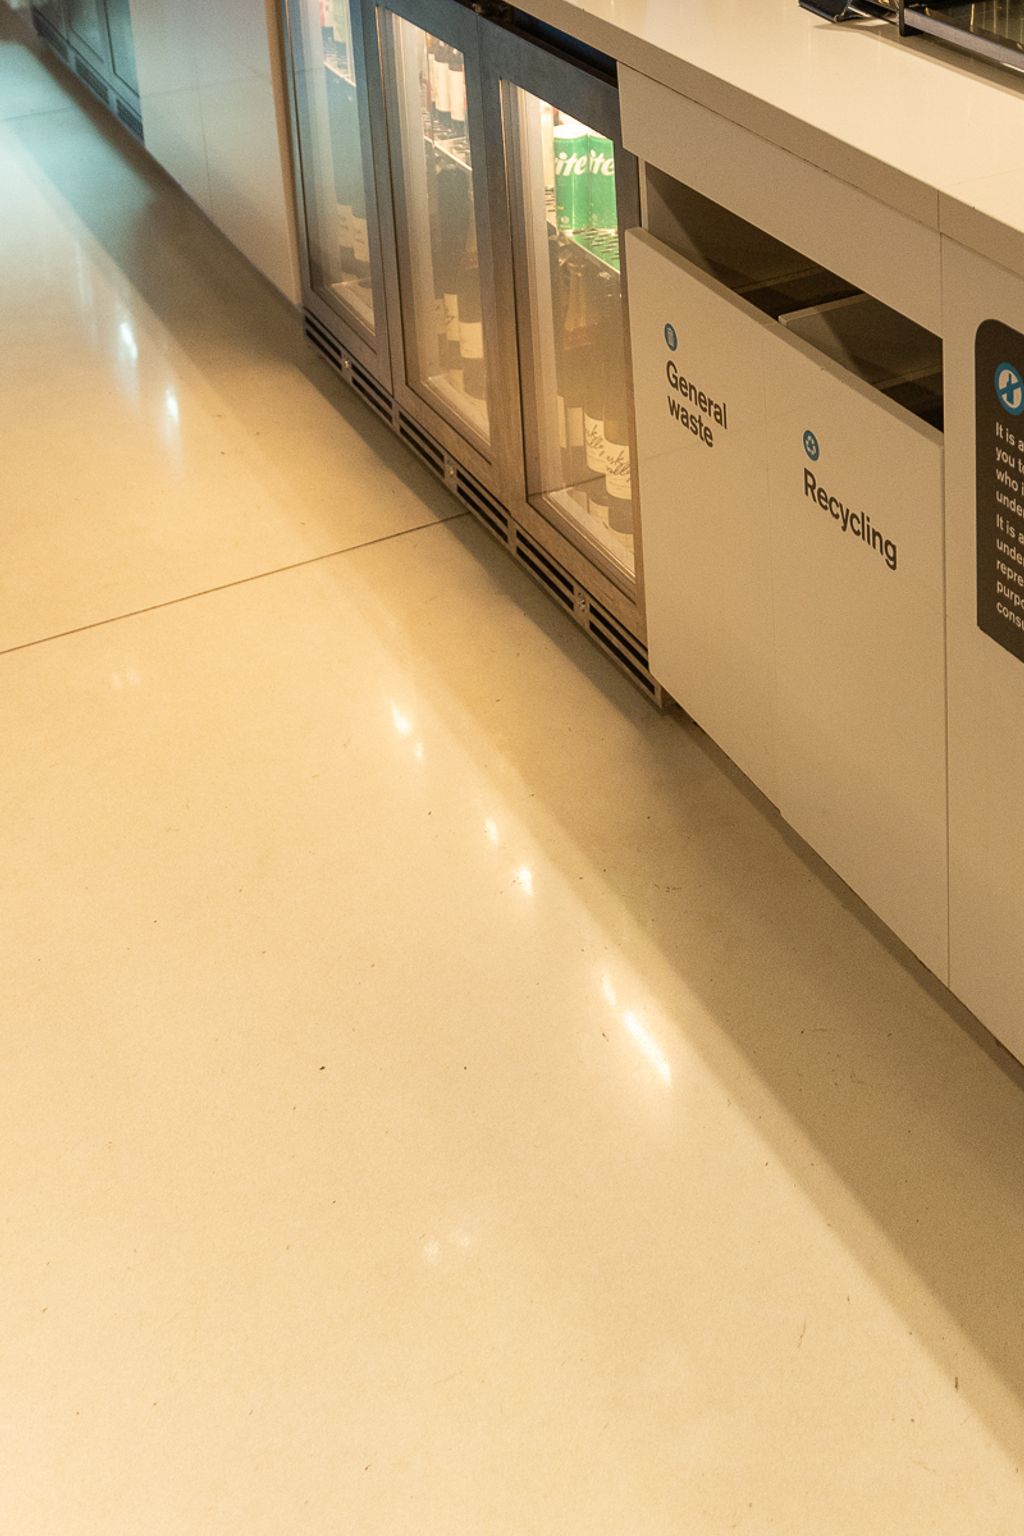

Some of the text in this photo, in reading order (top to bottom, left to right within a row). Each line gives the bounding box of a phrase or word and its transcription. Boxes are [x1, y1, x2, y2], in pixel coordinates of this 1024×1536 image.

[666, 360, 728, 430] General
[667, 395, 713, 448] waste
[996, 422, 1003, 437] It
[1006, 428, 1015, 446] is
[996, 447, 1015, 468] you
[996, 468, 1018, 492] who
[804, 467, 897, 571] Recycling
[996, 514, 1004, 530] It
[1006, 520, 1016, 538] is
